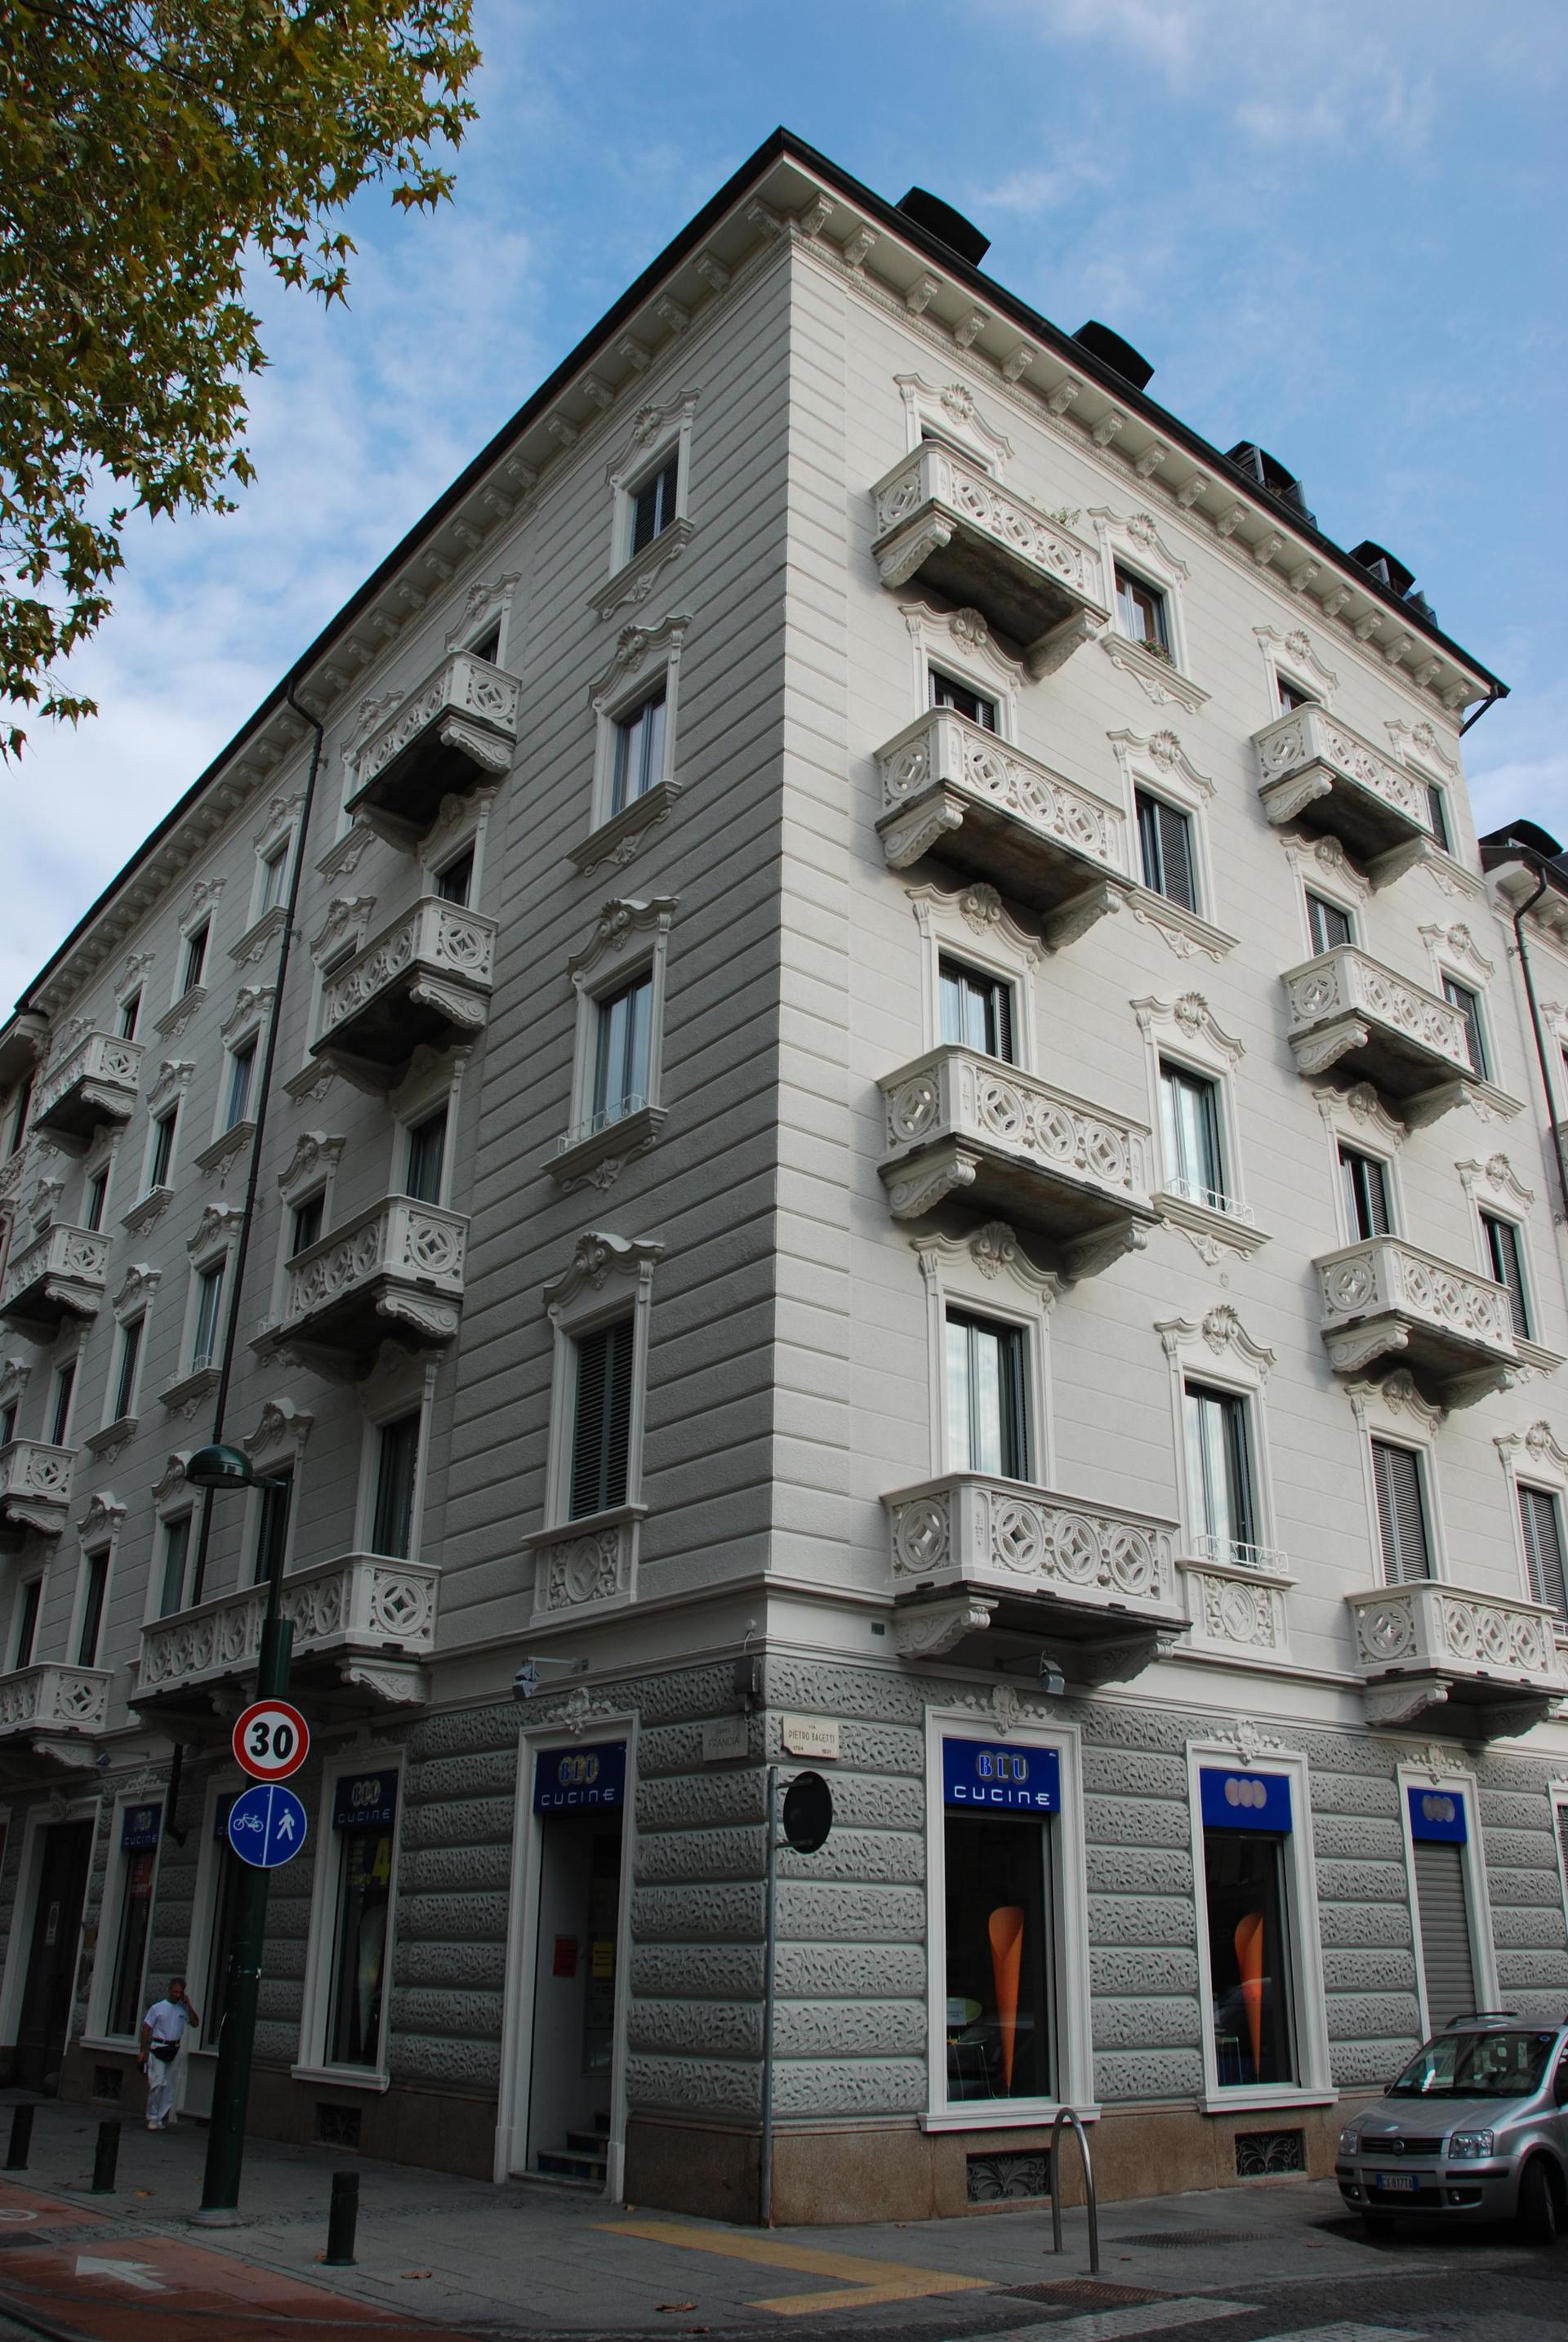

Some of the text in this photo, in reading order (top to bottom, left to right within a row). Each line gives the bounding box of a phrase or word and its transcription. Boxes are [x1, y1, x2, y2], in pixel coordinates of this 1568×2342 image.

[250, 1721, 293, 1760] 30
[788, 1730, 835, 1744] PIETRO BAGETTI
[560, 1758, 598, 1782] BLU
[978, 1754, 1027, 1780] BLU
[541, 1788, 615, 1806] CUCINE
[954, 1785, 1050, 1805] CUCINE
[338, 1808, 392, 1823] CUCINE
